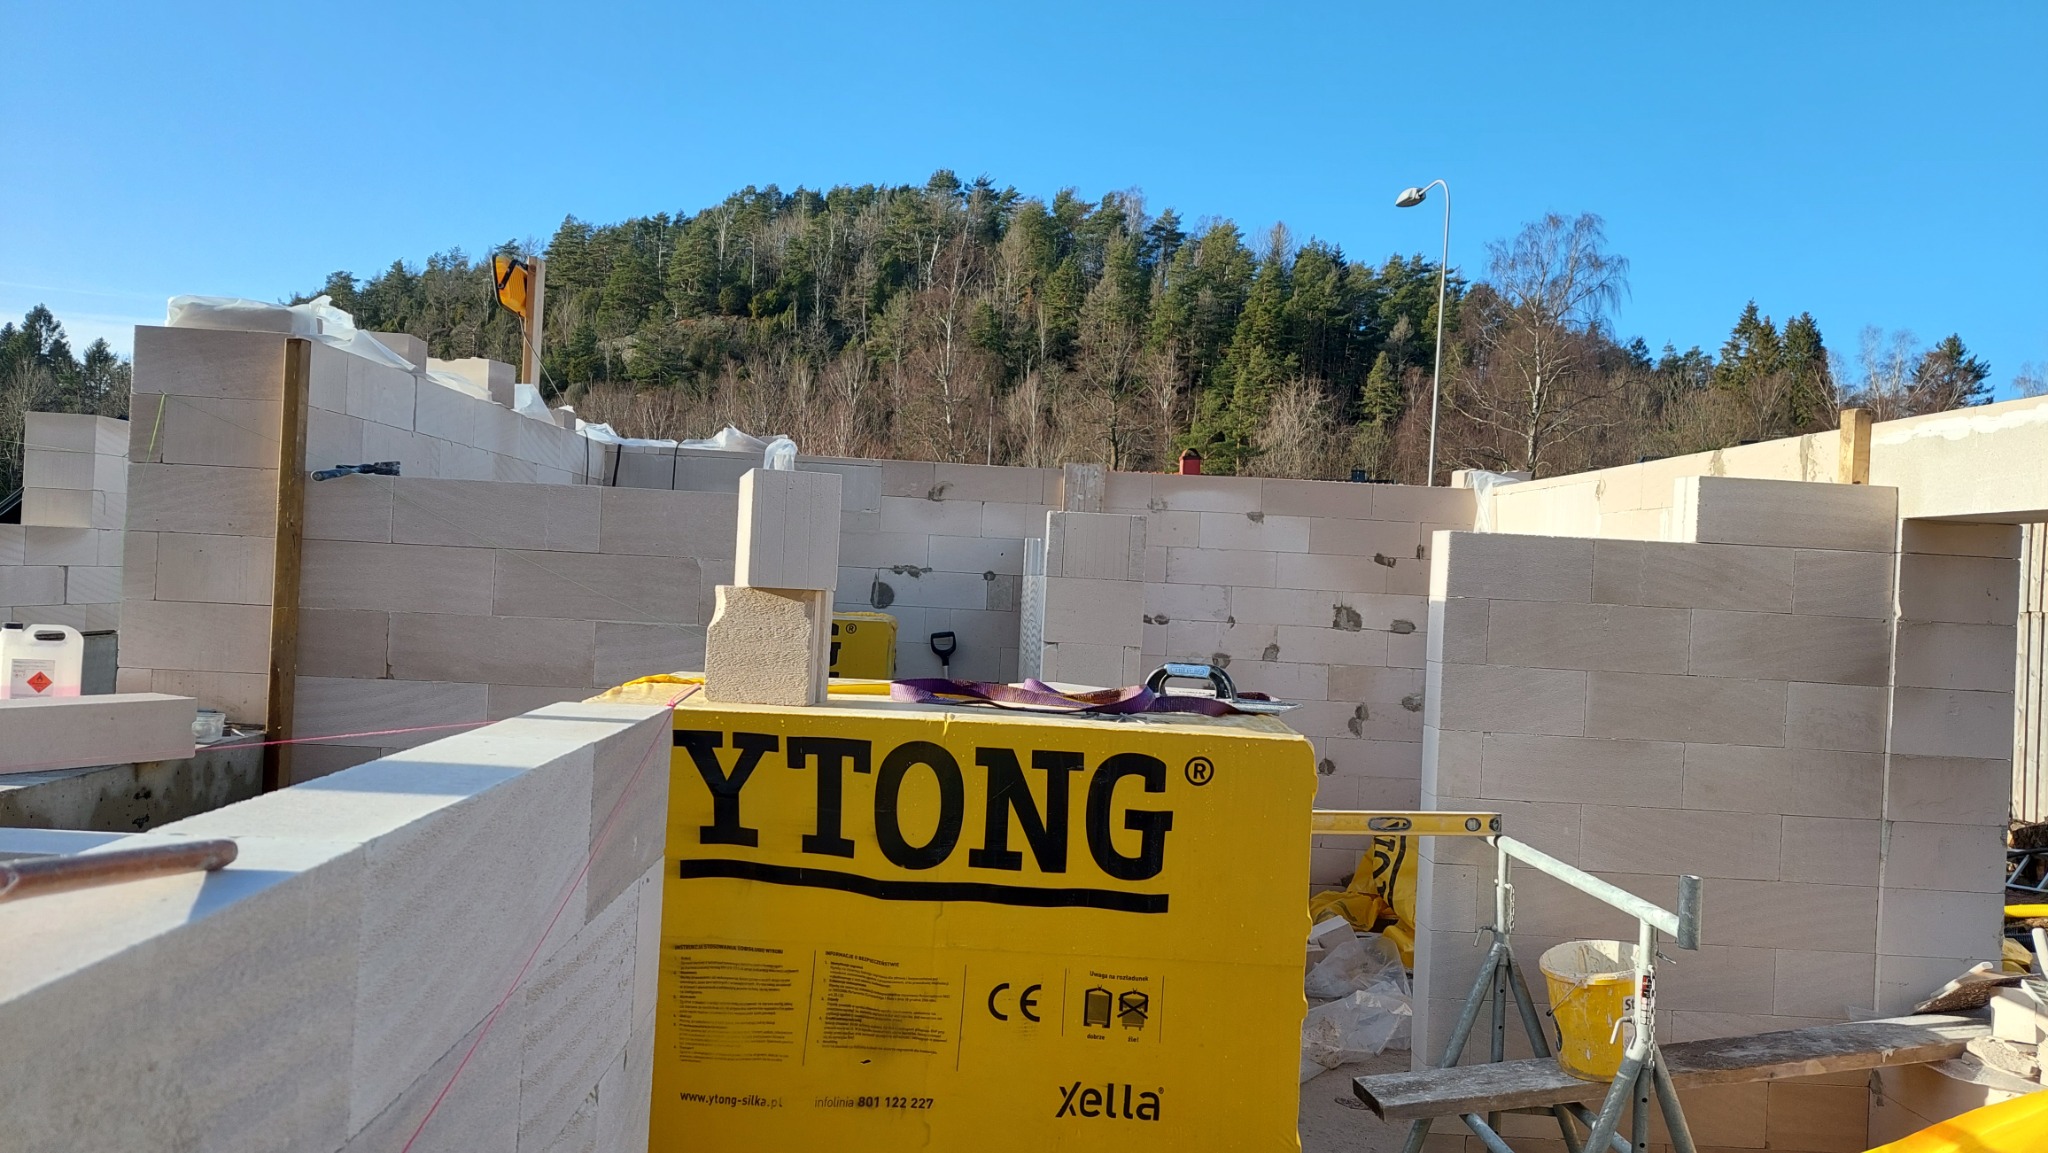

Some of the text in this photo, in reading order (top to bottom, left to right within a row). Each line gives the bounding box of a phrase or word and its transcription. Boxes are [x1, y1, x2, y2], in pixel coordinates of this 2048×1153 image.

[672, 729, 1173, 881] YTONG
[1089, 970, 1108, 980] Uwaga
[1087, 1032, 1105, 1041] dobrze
[679, 1092, 783, 1109] www.ytong-silka.pl
[814, 1096, 934, 1110] infolinia 801 122 227
